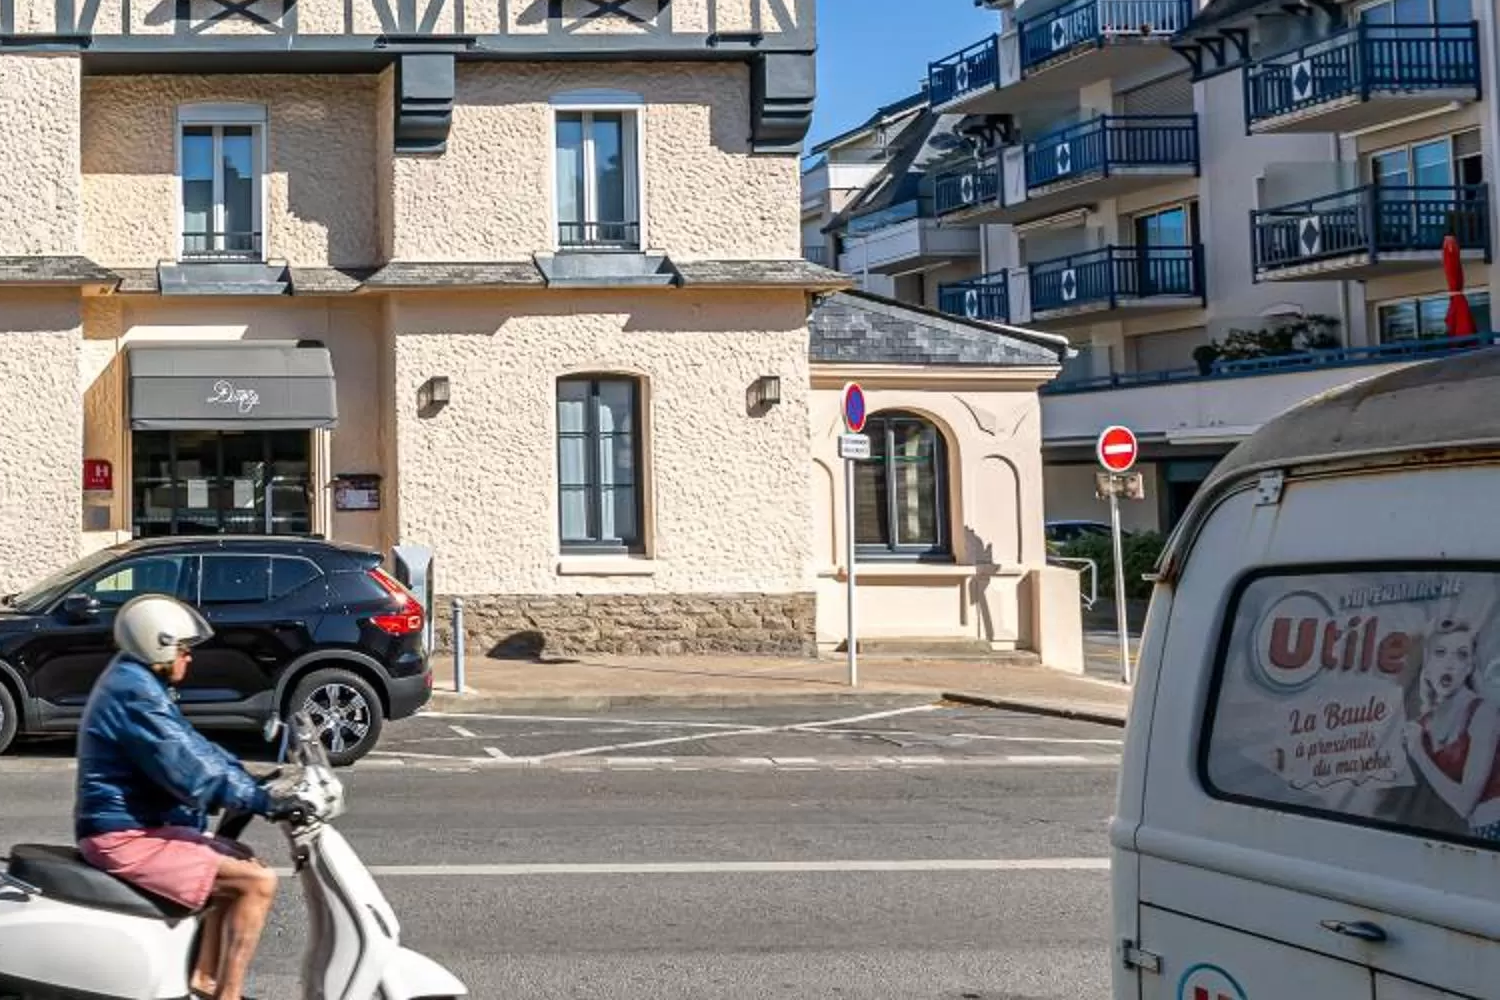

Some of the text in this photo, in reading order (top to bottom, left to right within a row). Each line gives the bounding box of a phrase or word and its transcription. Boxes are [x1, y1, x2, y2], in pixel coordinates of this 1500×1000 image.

[1268, 615, 1410, 675] Utile
[1288, 695, 1386, 736] La Baule
